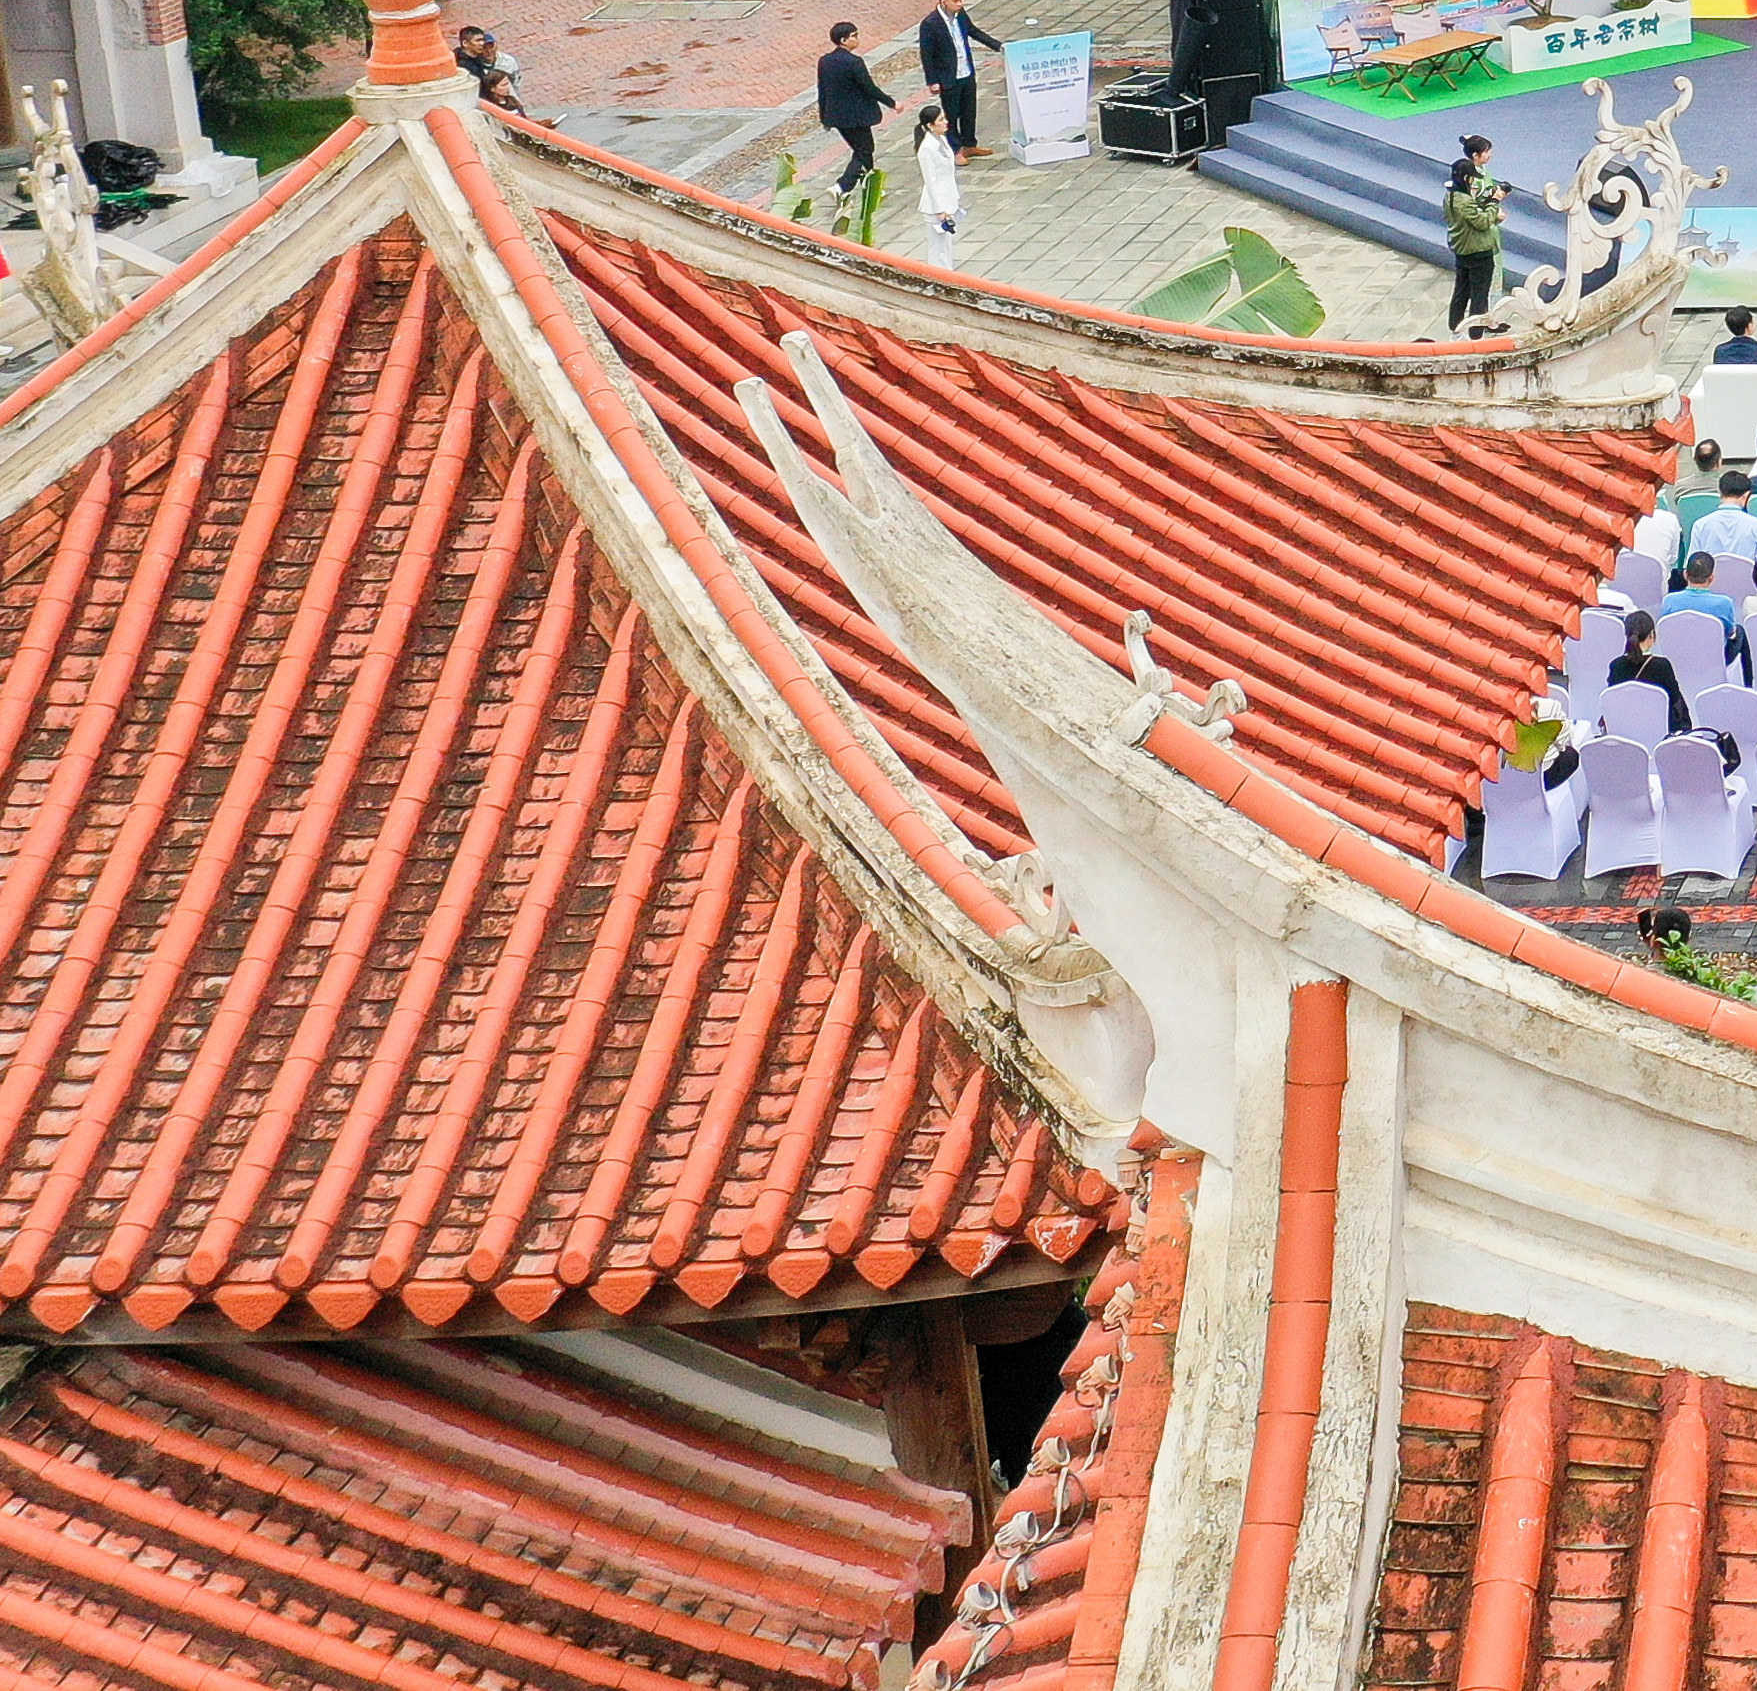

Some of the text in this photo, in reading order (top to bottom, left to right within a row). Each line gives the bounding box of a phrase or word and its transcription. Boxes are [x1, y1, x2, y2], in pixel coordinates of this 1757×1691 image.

[1544, 12, 1660, 53] 百年老茶树
